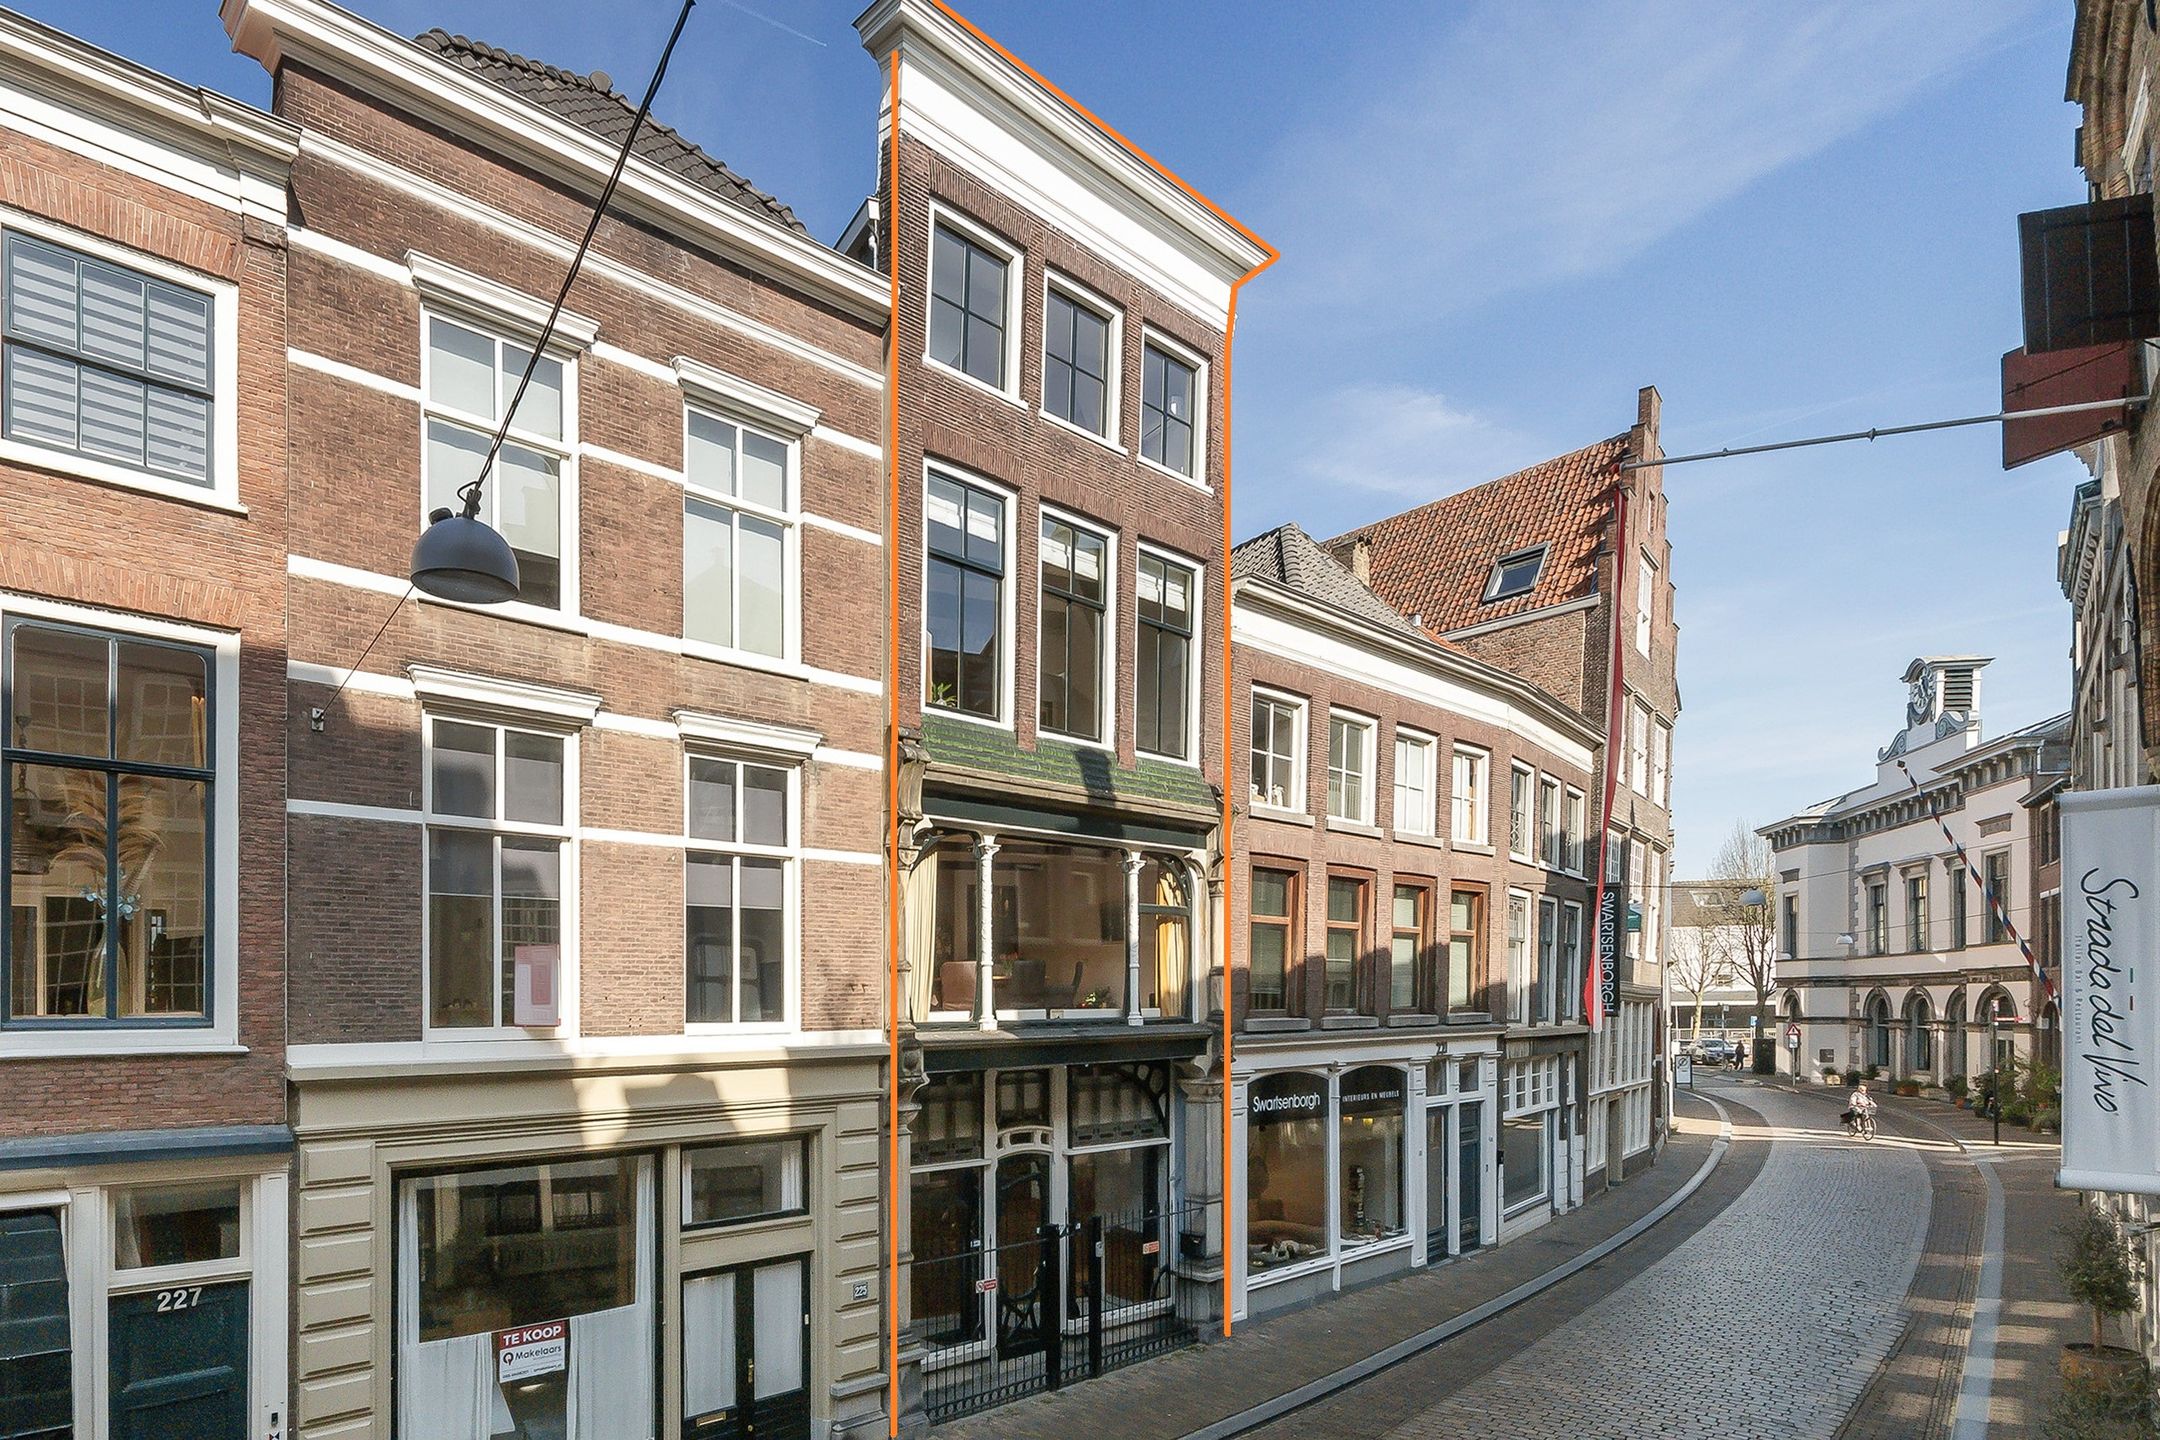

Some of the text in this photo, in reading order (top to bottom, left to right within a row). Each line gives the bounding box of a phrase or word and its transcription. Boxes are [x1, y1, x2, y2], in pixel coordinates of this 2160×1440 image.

[1601, 891, 1615, 1012] SWARTSENBORGH
[2081, 868, 2148, 1113] Strada del Vino
[1253, 1092, 1320, 1112] Swartsenborgh
[157, 1286, 202, 1312] 227
[503, 1325, 562, 1346] TE KOOP
[515, 1346, 562, 1360] Makelaars
